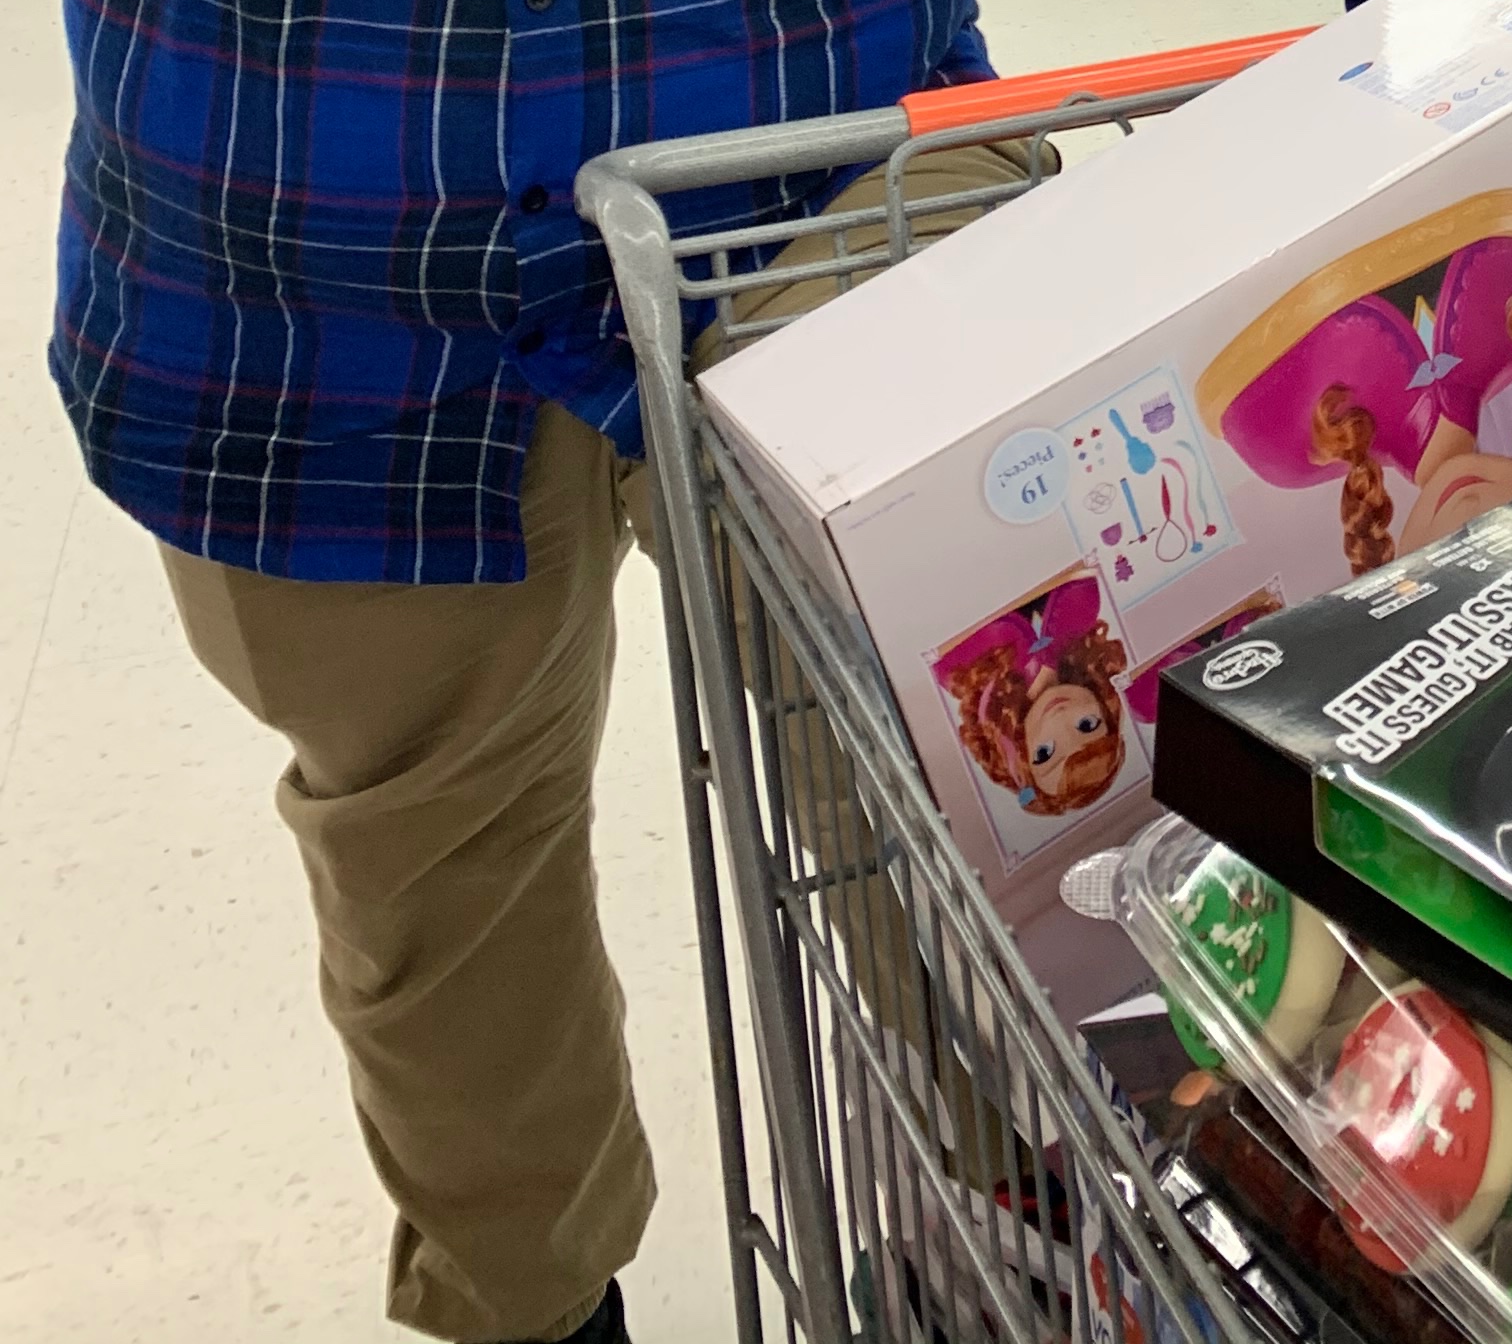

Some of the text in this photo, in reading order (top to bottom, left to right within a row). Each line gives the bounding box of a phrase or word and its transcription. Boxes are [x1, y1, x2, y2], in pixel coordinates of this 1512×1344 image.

[997, 444, 1055, 489] Pieces!
[1021, 473, 1049, 505] 19
[1438, 618, 1484, 653] IT
[1333, 644, 1446, 733] GAME!
[1382, 674, 1468, 735] GUESS
